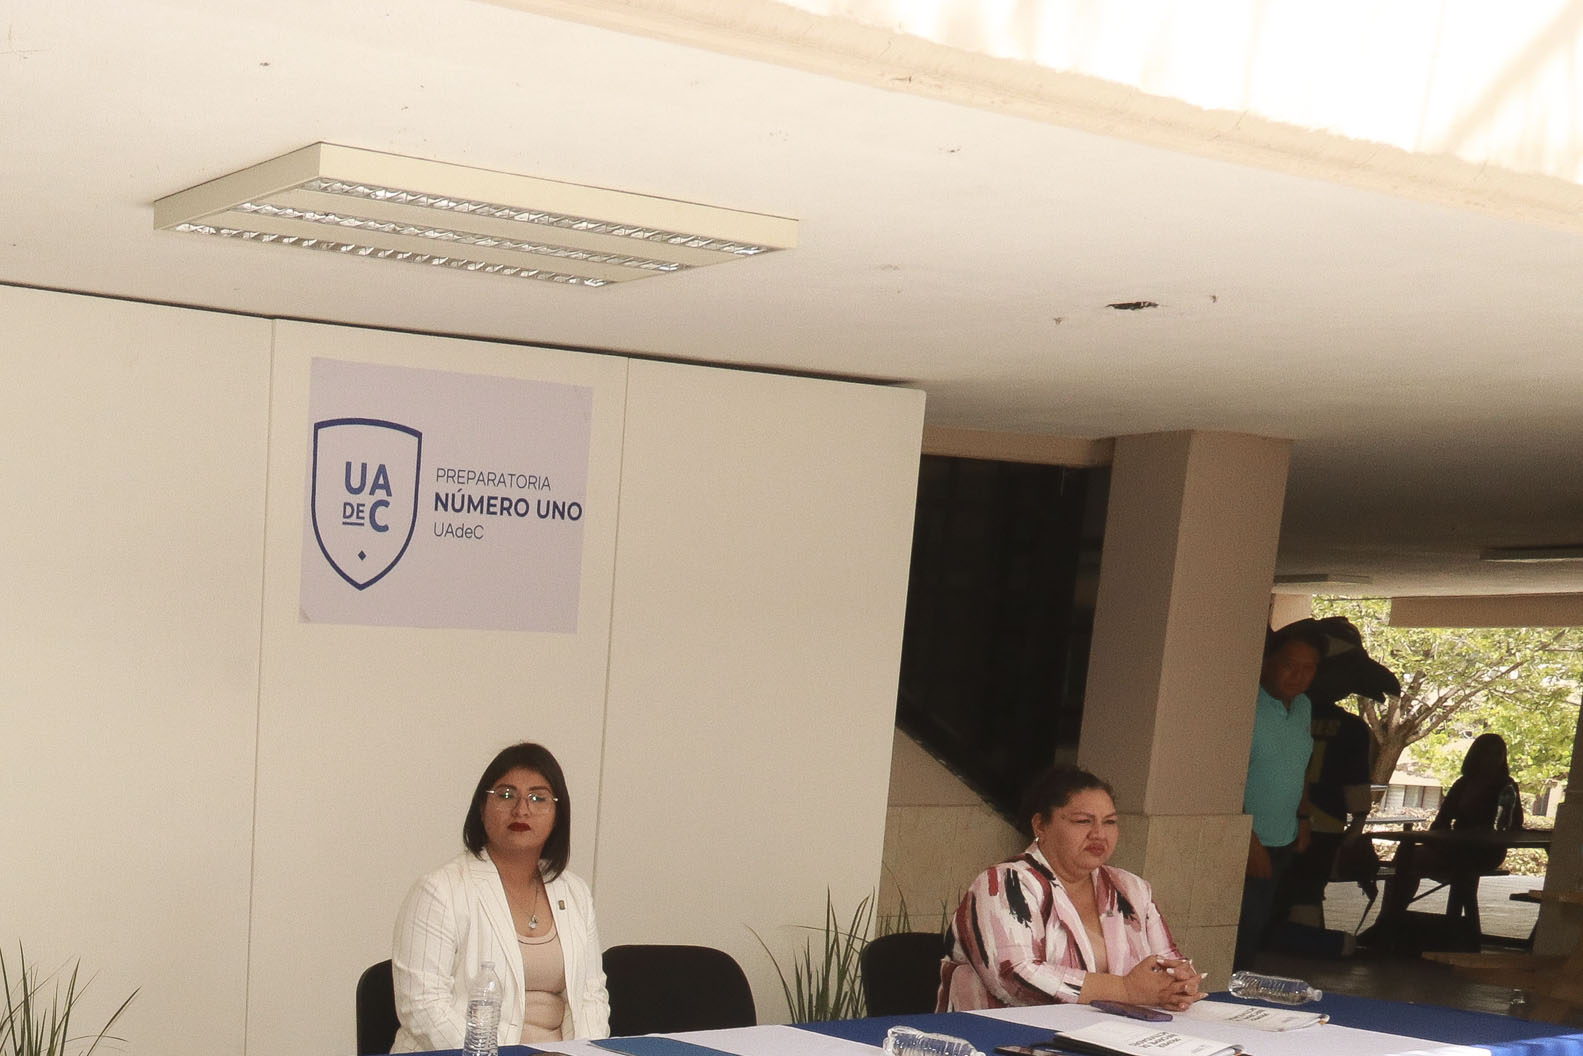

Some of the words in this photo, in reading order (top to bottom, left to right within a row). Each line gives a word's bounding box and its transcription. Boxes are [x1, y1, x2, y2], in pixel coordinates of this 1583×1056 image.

[344, 460, 393, 498] UA
[436, 467, 552, 491] PREPARATORIA
[342, 501, 366, 521] DE
[368, 499, 391, 533] C
[433, 488, 530, 518] NÚMERO
[536, 498, 583, 522] UNO
[433, 522, 485, 540] UAdeC
